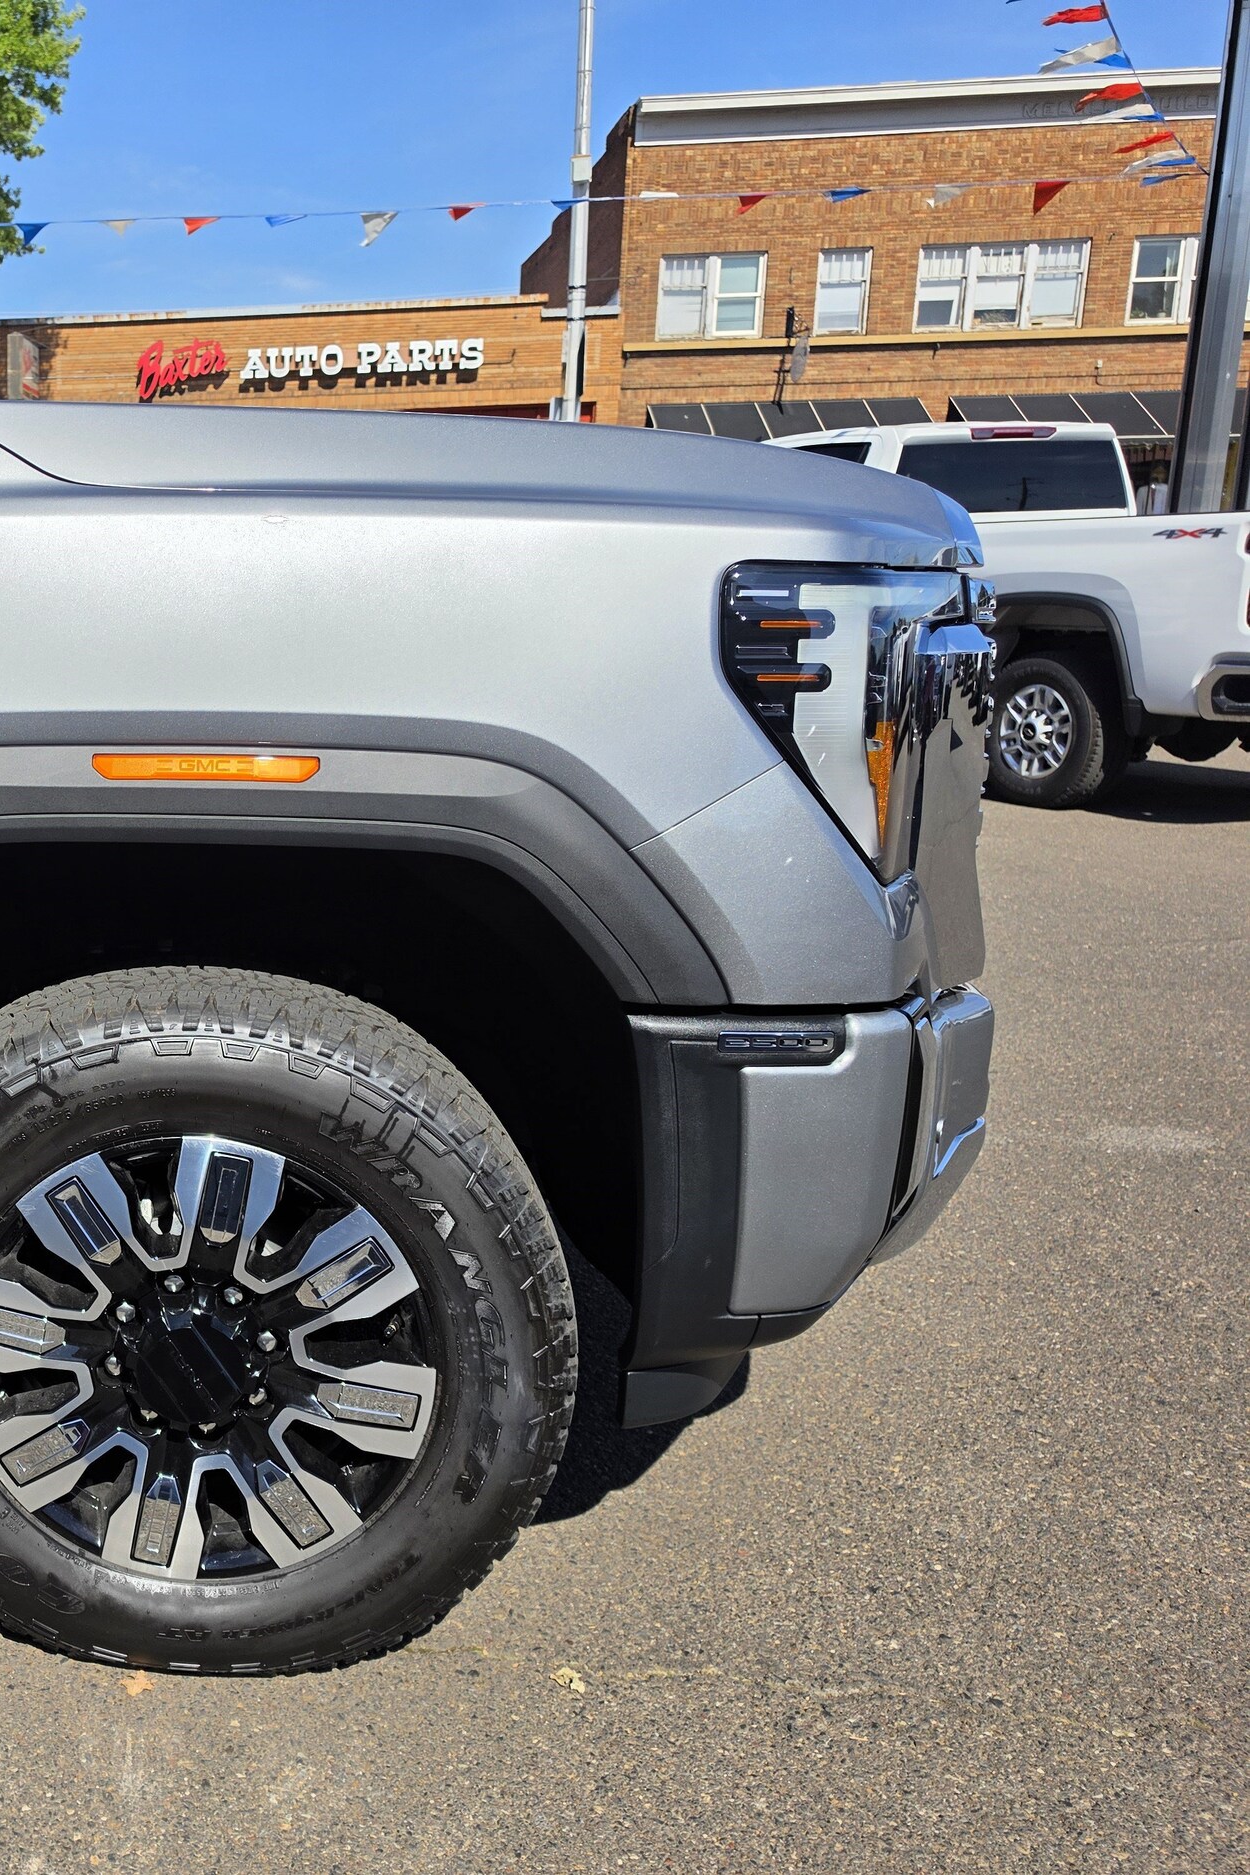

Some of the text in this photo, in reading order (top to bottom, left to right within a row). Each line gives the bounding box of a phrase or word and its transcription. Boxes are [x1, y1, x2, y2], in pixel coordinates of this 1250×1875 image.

[137, 338, 485, 399] Baxter AUTO PARTS
[177, 758, 231, 773] GMC
[723, 1036, 829, 1049] 2500
[318, 1110, 510, 1505] WRANGLER
